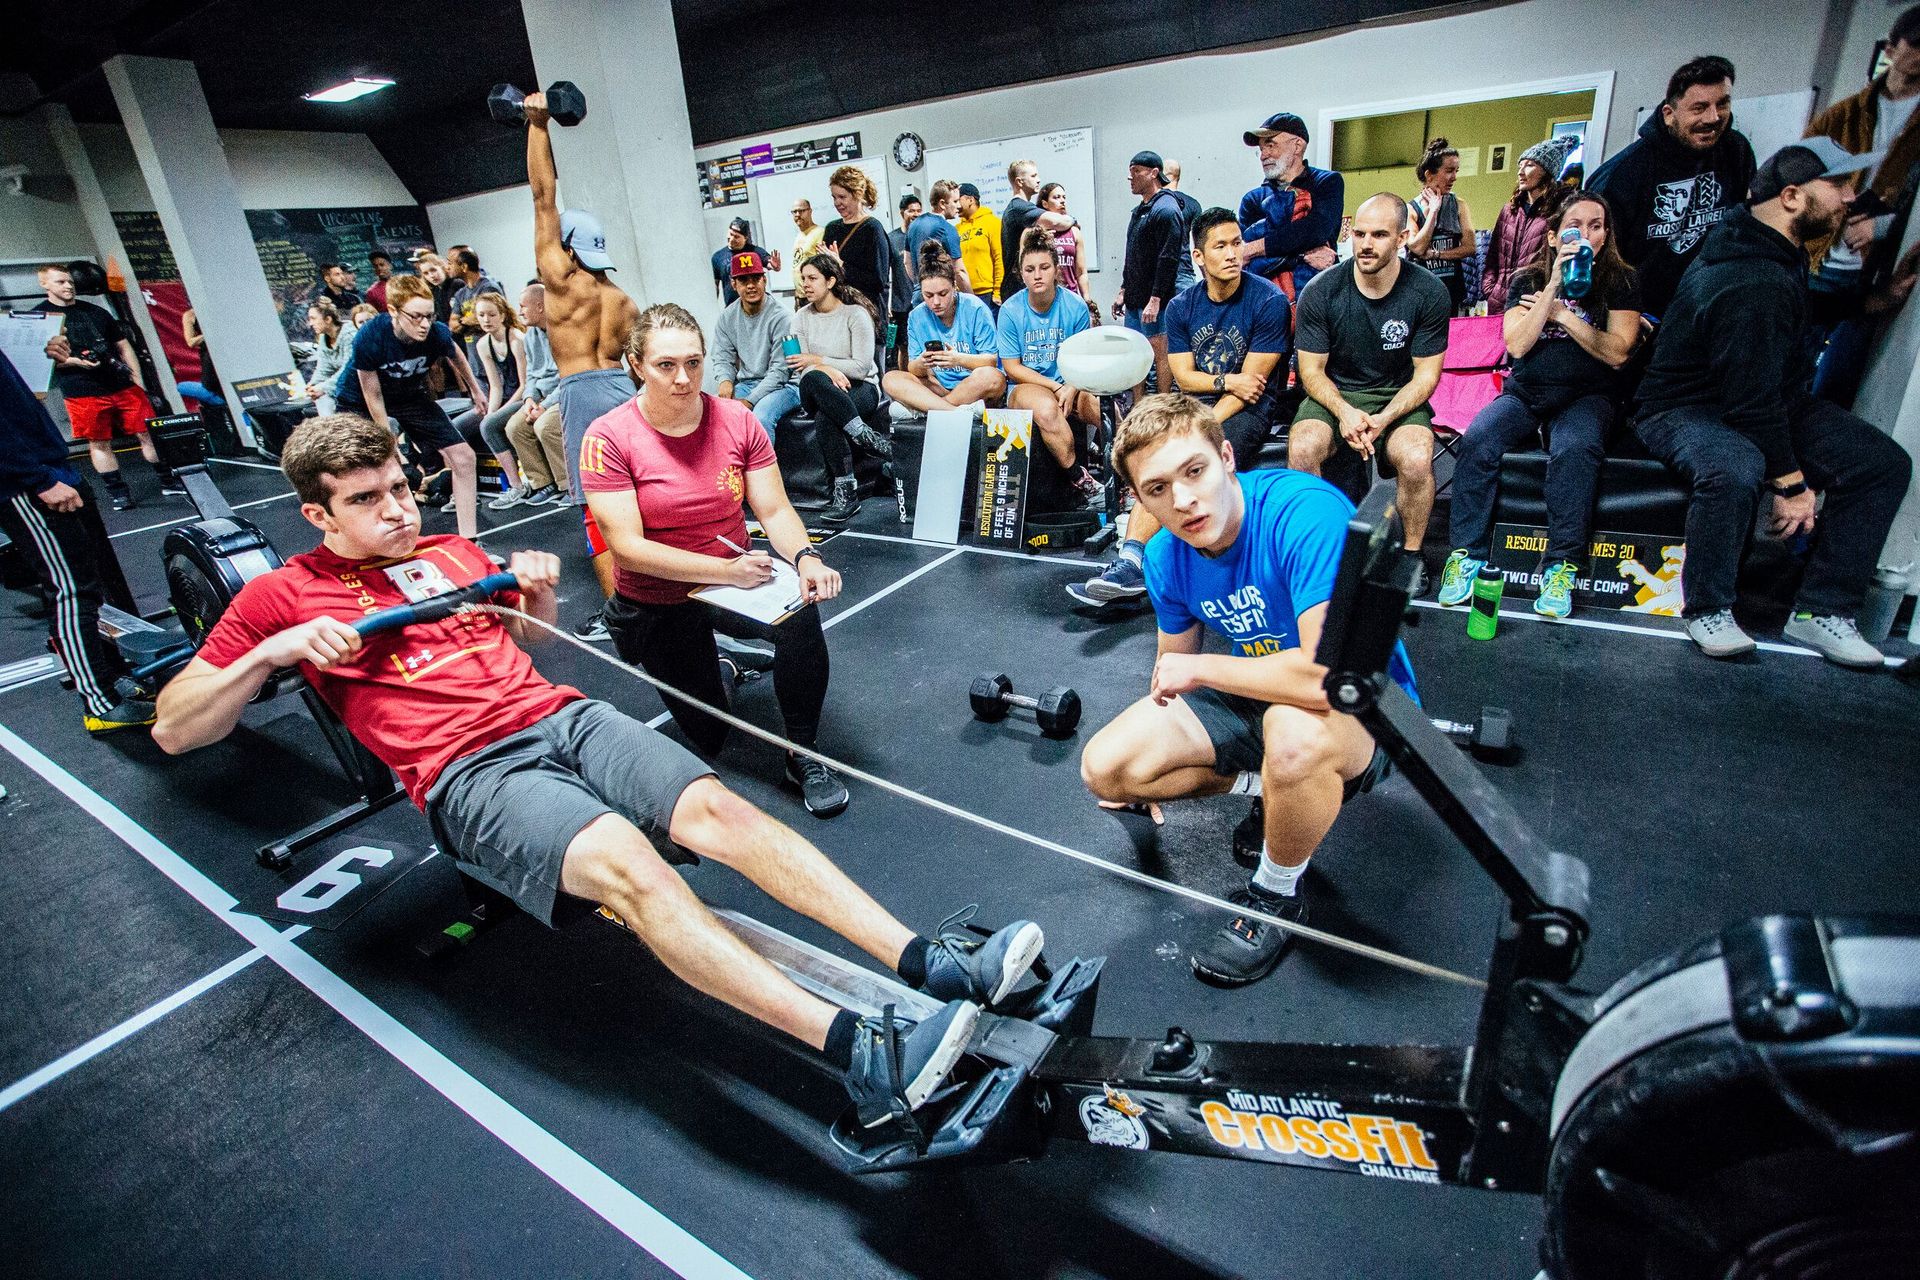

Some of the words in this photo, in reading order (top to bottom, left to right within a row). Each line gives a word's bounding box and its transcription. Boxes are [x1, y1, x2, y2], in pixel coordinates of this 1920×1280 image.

[318, 211, 384, 228] UPCOMING
[1688, 209, 1723, 228] LAUREL
[373, 224, 423, 241] EVENTS
[739, 255, 753, 268] M
[1025, 329, 1046, 343] OUTH
[1382, 341, 1406, 350] COACH
[987, 452, 997, 462] 20
[985, 463, 996, 489] GAMES
[998, 464, 1009, 496] INCHES
[895, 477, 907, 523] ROGUE
[980, 491, 994, 536] RESOLUTION
[995, 506, 1005, 527] FEET
[1005, 507, 1016, 525] FUN
[994, 529, 1003, 538] 12
[1004, 527, 1014, 539] OF
[1505, 535, 1549, 552] RESOLU
[1591, 542, 1616, 558] MES
[1619, 544, 1635, 560] 20
[1502, 570, 1529, 584] TWO
[1574, 578, 1590, 591] NE
[1594, 580, 1630, 594] COMP
[276, 845, 394, 914] 6
[1226, 1090, 1260, 1112] MID
[1259, 1094, 1345, 1120] ATLANTIC
[1200, 1100, 1440, 1171] CrossFit
[1359, 1162, 1441, 1185] CHALLENGE
